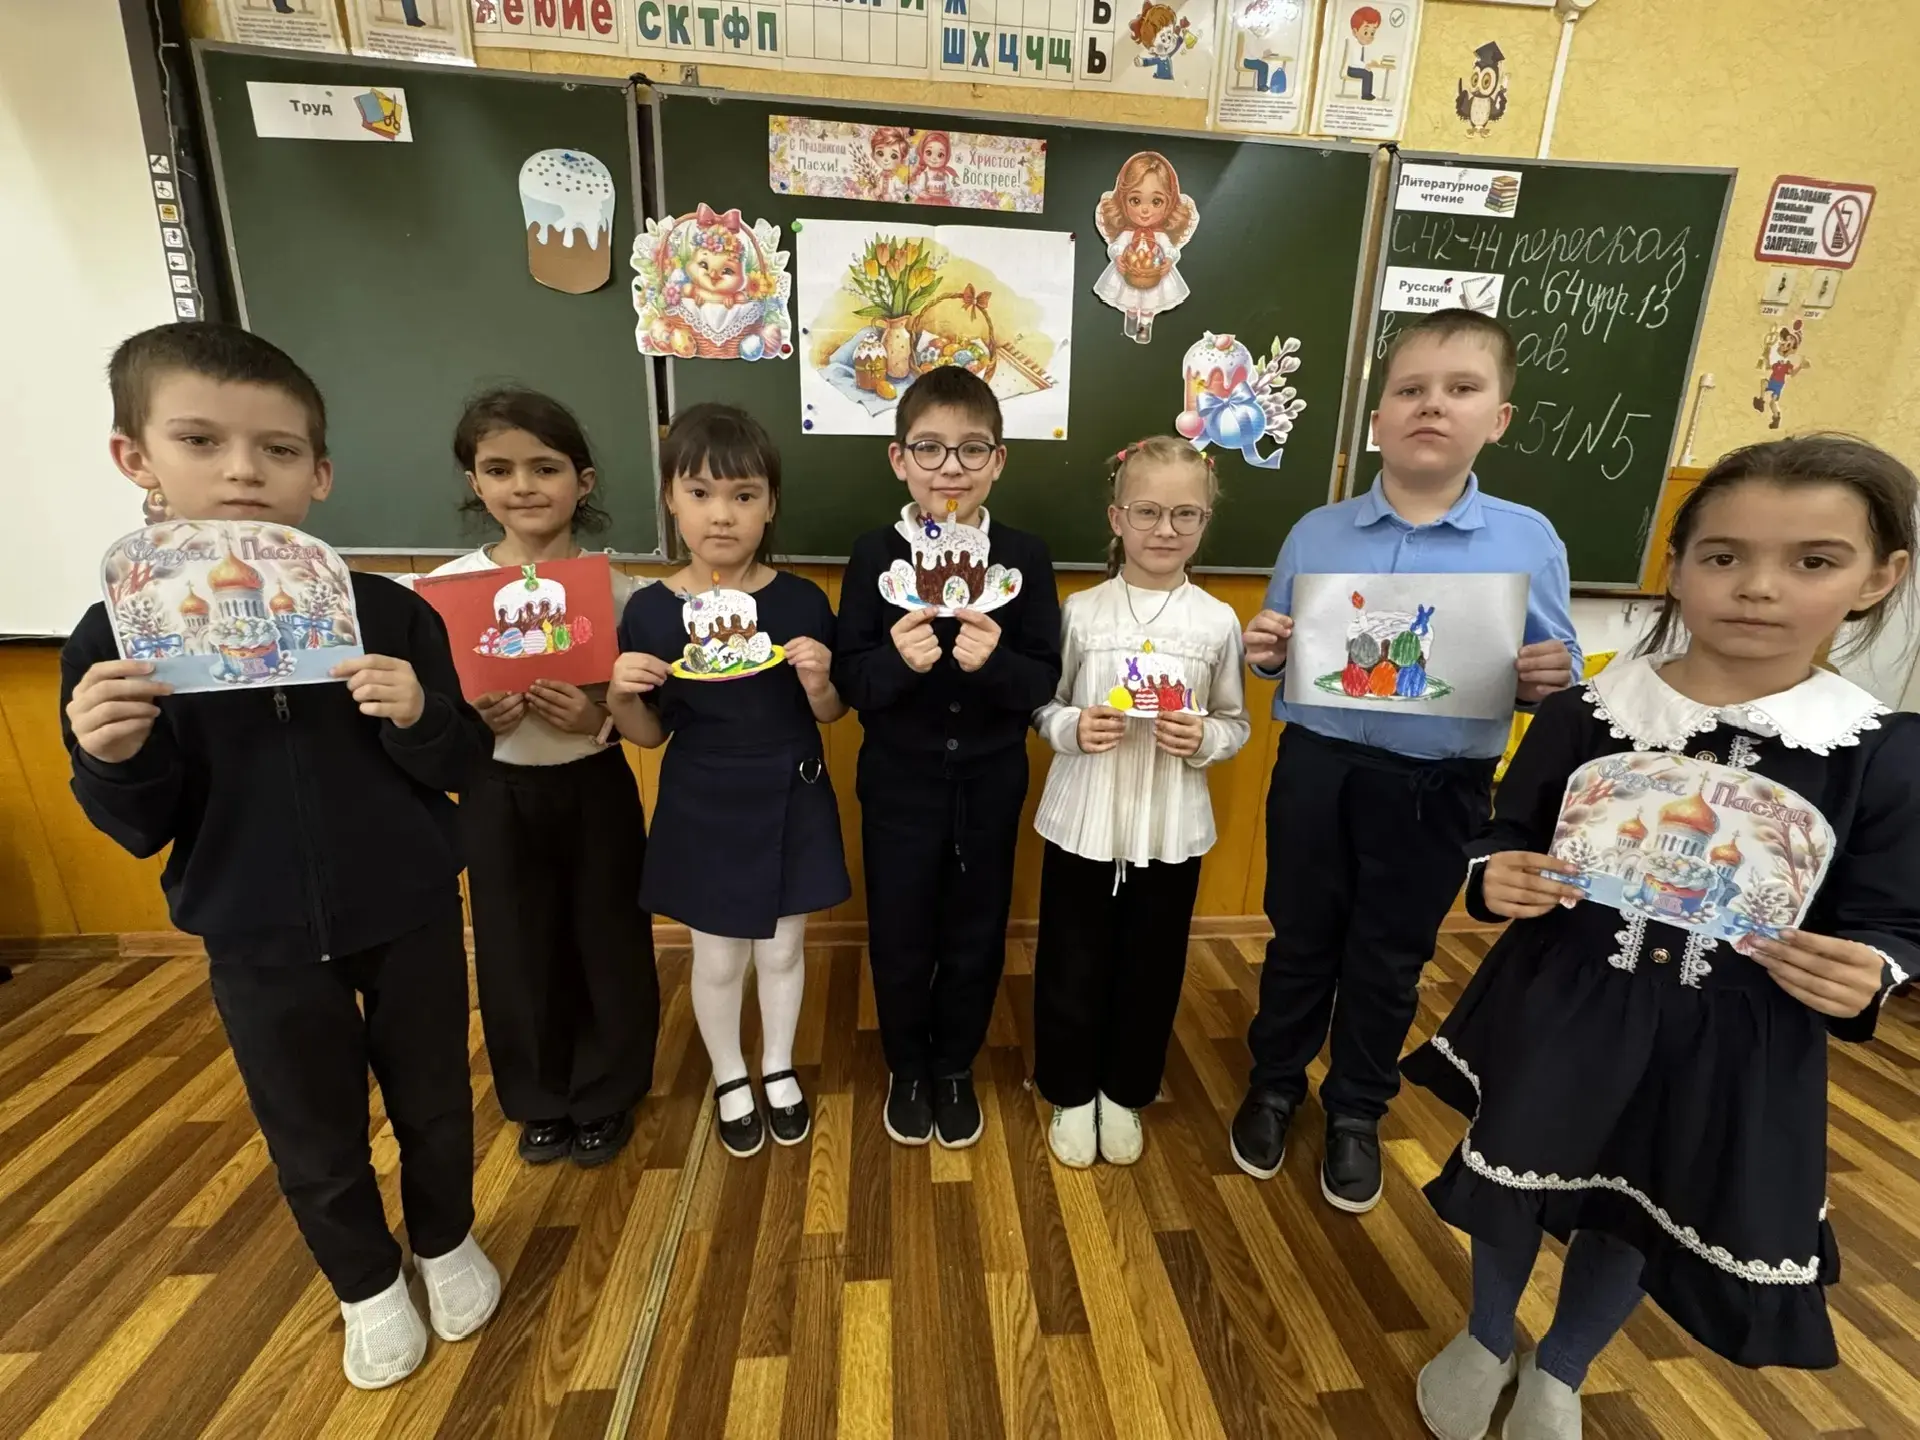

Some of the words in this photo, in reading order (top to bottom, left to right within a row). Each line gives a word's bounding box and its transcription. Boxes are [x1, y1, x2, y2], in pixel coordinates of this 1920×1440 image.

[289, 99, 333, 116] Труд
[797, 156, 839, 172] Пасхи!
[969, 150, 1016, 170] Христос
[962, 169, 1021, 188] Воскресе!
[1400, 174, 1489, 193] Литературное
[1421, 191, 1464, 204] чтение
[1764, 235, 1818, 255] ЗАПРЕЩЕНО!
[1399, 280, 1452, 295] Русский
[1407, 295, 1439, 308] язык
[240, 536, 326, 564] Пасхи
[1710, 781, 1813, 828] Пасхи
